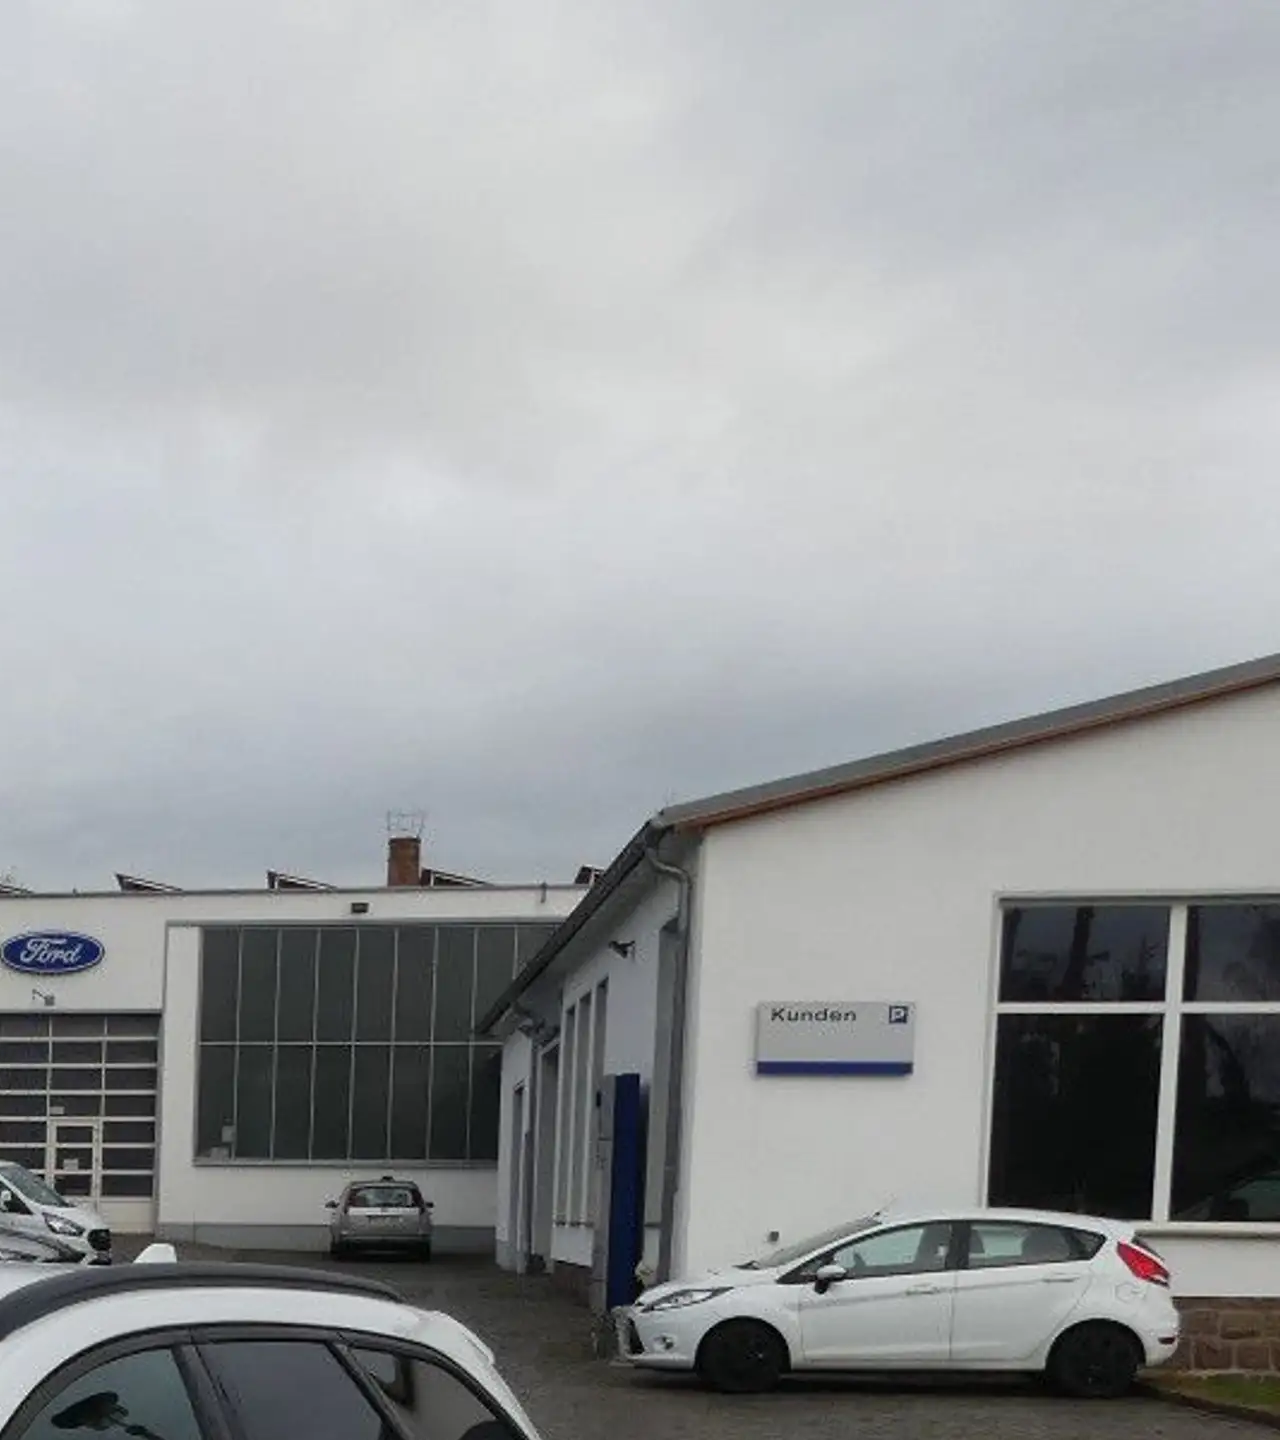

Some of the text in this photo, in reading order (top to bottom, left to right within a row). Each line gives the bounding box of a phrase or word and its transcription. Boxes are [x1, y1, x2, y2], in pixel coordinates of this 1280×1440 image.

[20, 937, 83, 963] Ford
[771, 1007, 906, 1022] Kunden P
